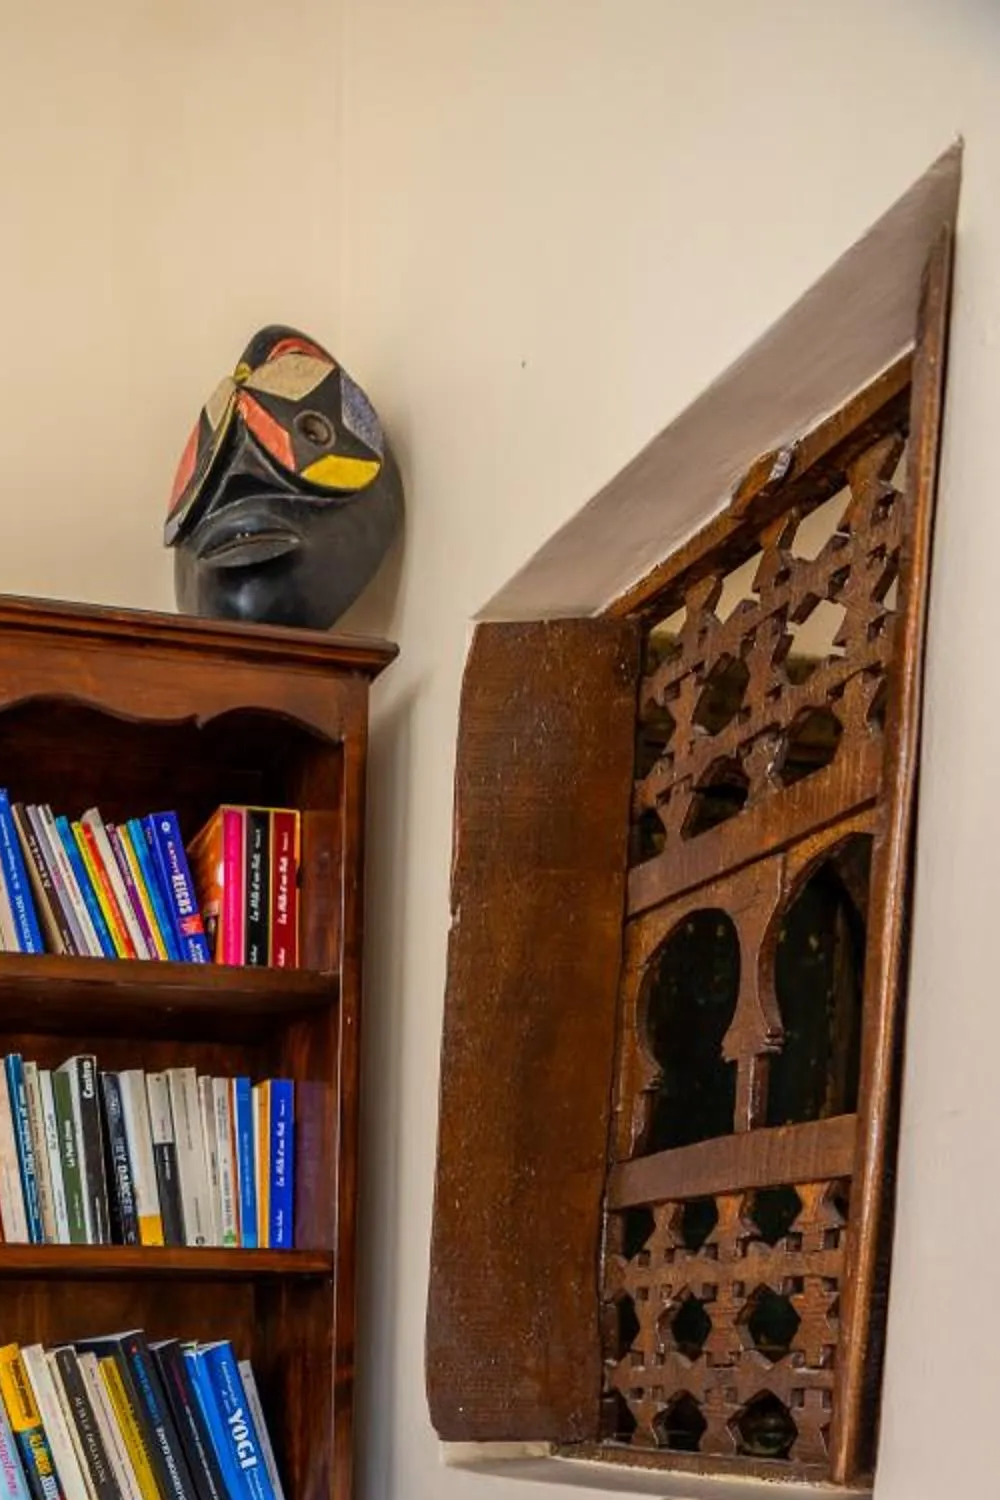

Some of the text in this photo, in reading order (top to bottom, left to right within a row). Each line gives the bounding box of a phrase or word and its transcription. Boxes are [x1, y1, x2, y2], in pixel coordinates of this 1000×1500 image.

[171, 873, 193, 915] REICHS
[81, 1060, 95, 1099] Castro
[227, 1407, 258, 1470] YOGI
